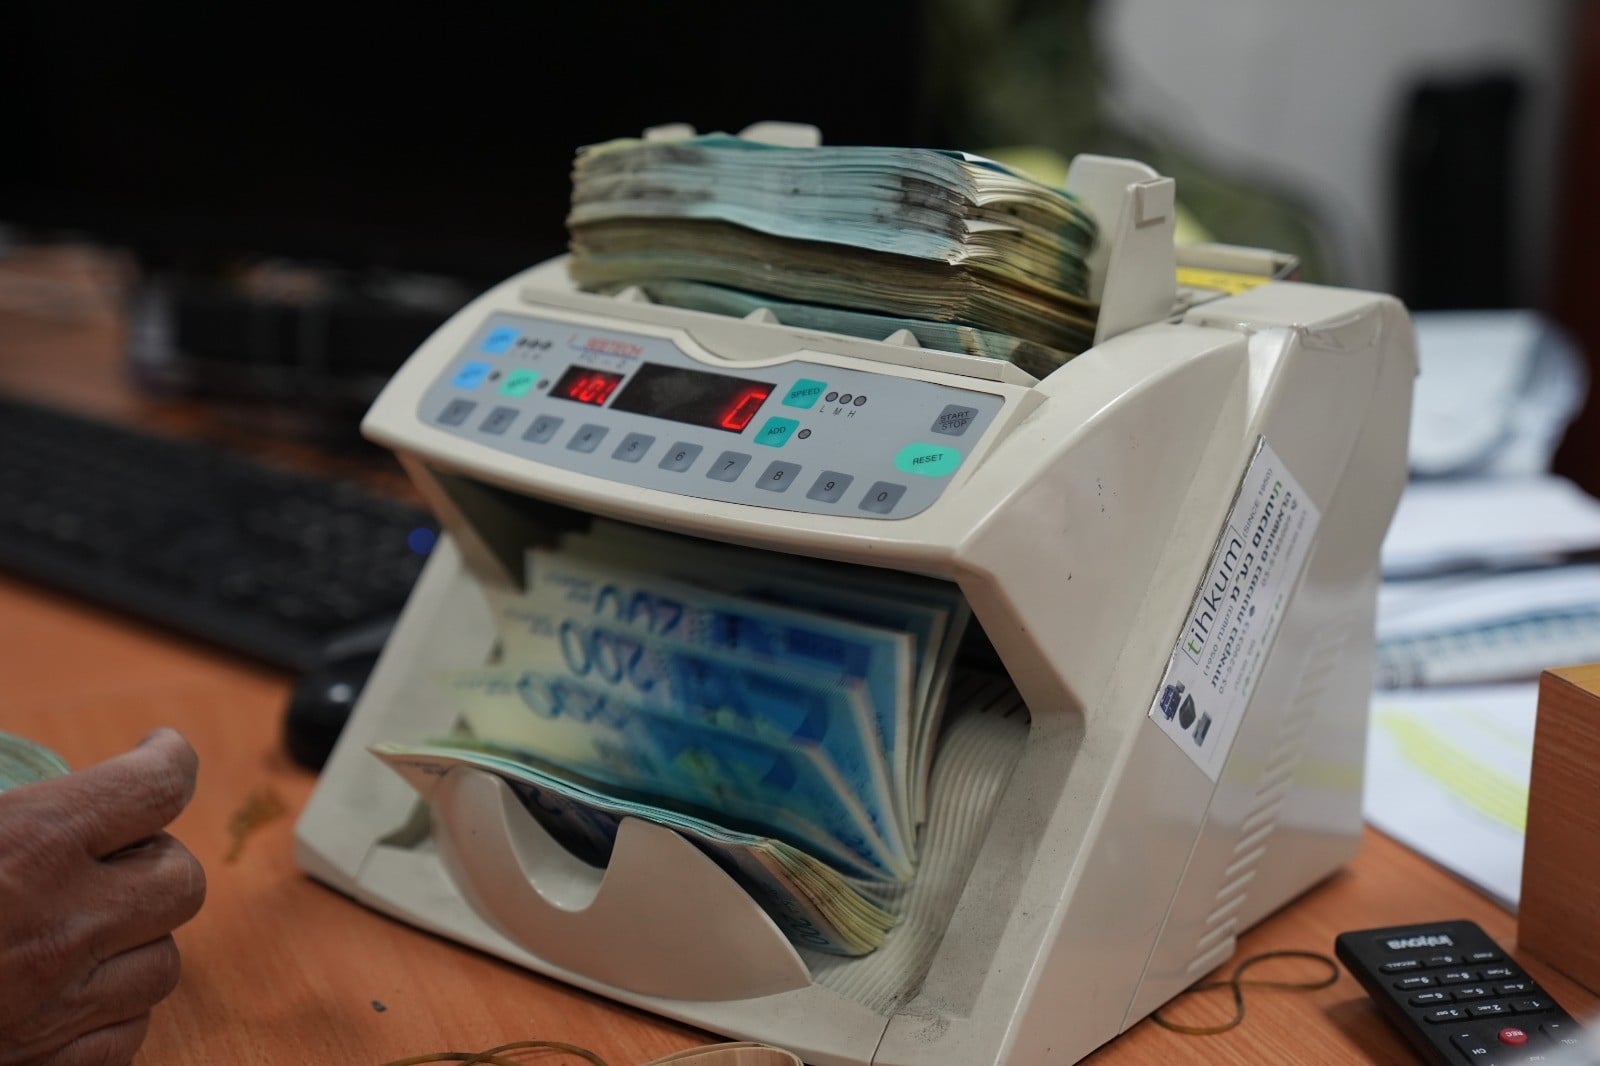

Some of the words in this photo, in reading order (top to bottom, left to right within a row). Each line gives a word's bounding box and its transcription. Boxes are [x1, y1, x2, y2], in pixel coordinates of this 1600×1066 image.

[790, 387, 821, 399] SPEED
[832, 408, 842, 416] M
[847, 409, 857, 418] H
[939, 410, 970, 424] START
[767, 425, 786, 437] ADD
[941, 420, 968, 431] STOP
[912, 453, 944, 466] RESET
[674, 450, 686, 462] 6
[724, 460, 736, 471] 7
[772, 470, 784, 481] 8
[823, 480, 836, 492] 9
[876, 490, 888, 503] 0
[1252, 480, 1281, 547] תיחכום
[1260, 491, 1291, 562] הראשונים
[1187, 538, 1241, 654] tihkum
[558, 619, 656, 693] 200
[1491, 1004, 1502, 1012] 2
[1504, 1030, 1525, 1038] REC
